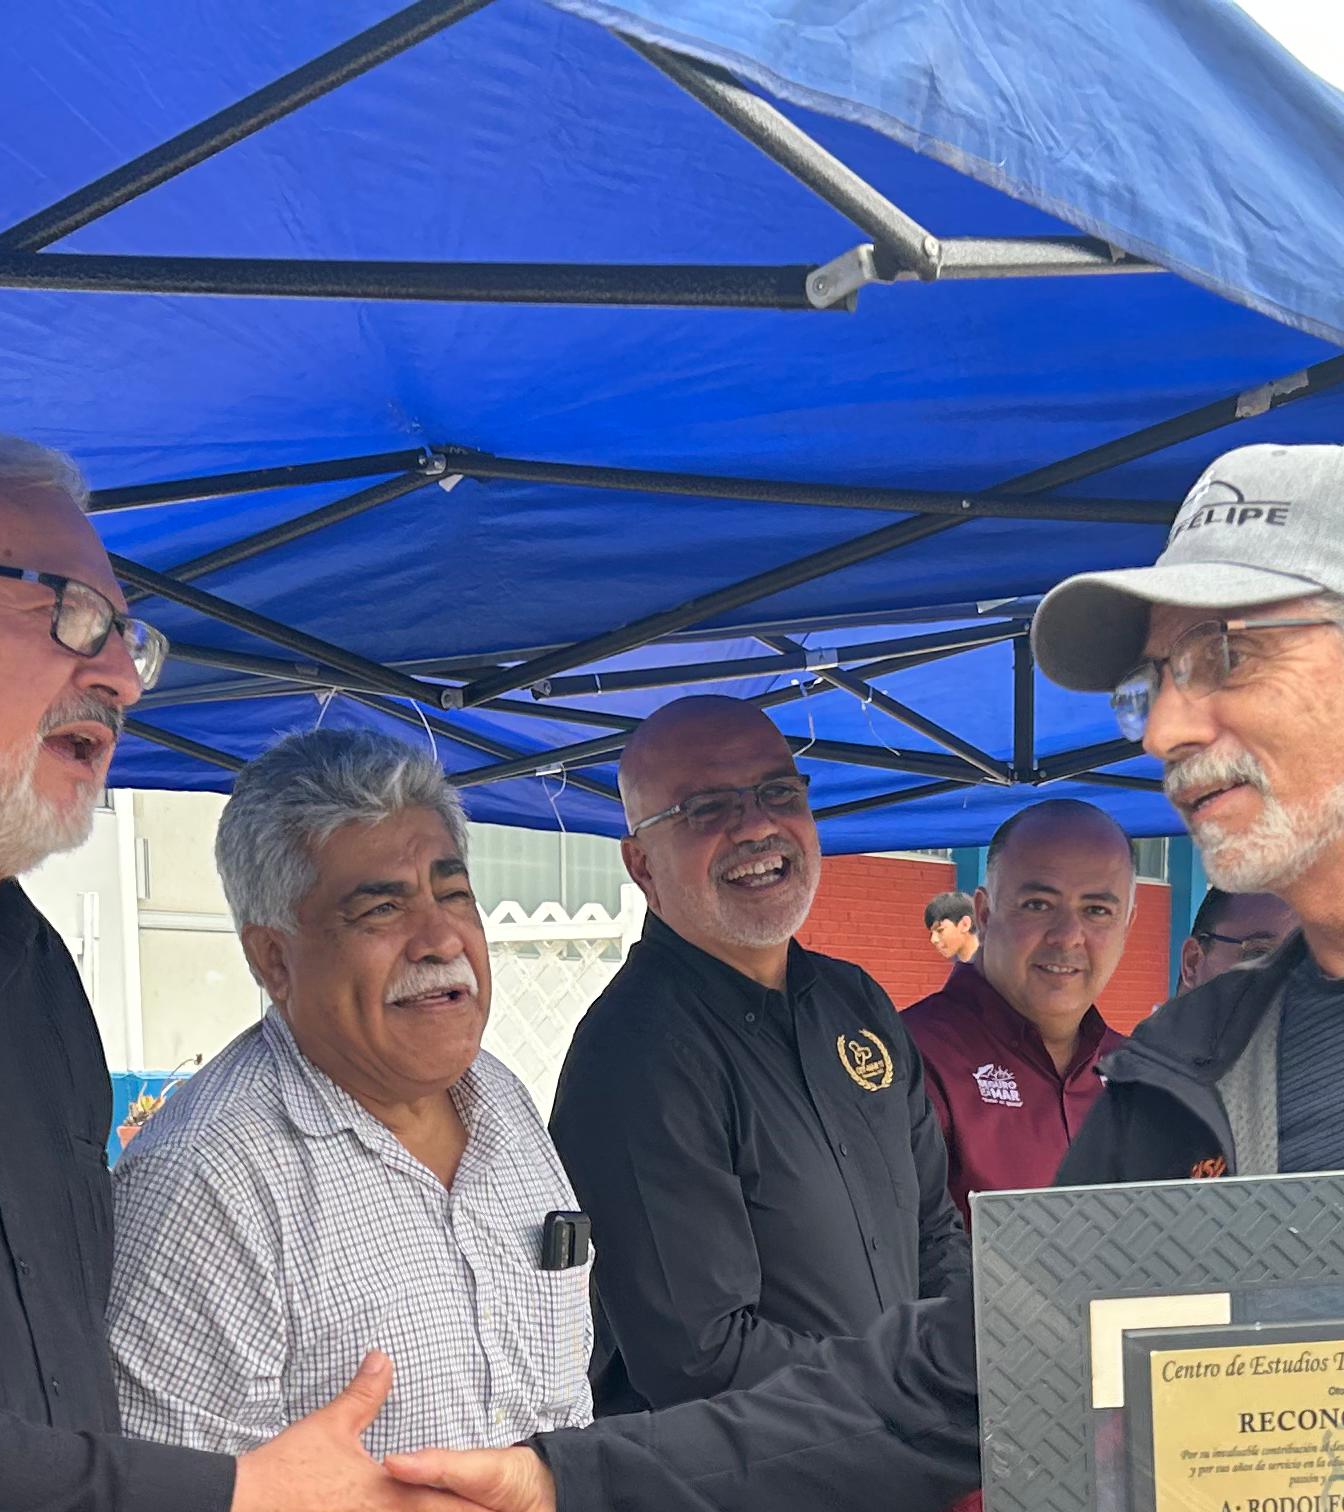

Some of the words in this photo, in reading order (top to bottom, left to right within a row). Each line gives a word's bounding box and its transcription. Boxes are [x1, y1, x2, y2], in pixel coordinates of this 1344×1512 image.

[990, 1088, 1021, 1102] MAR
[1162, 1360, 1220, 1382] Centro
[1225, 1354, 1245, 1377] de
[1249, 1351, 1329, 1376] Estudios
[1197, 1466, 1214, 1478] por
[1255, 1460, 1266, 1471] de
[1268, 1459, 1301, 1470] servicio
[1303, 1460, 1314, 1469] en
[1316, 1456, 1325, 1468] la
